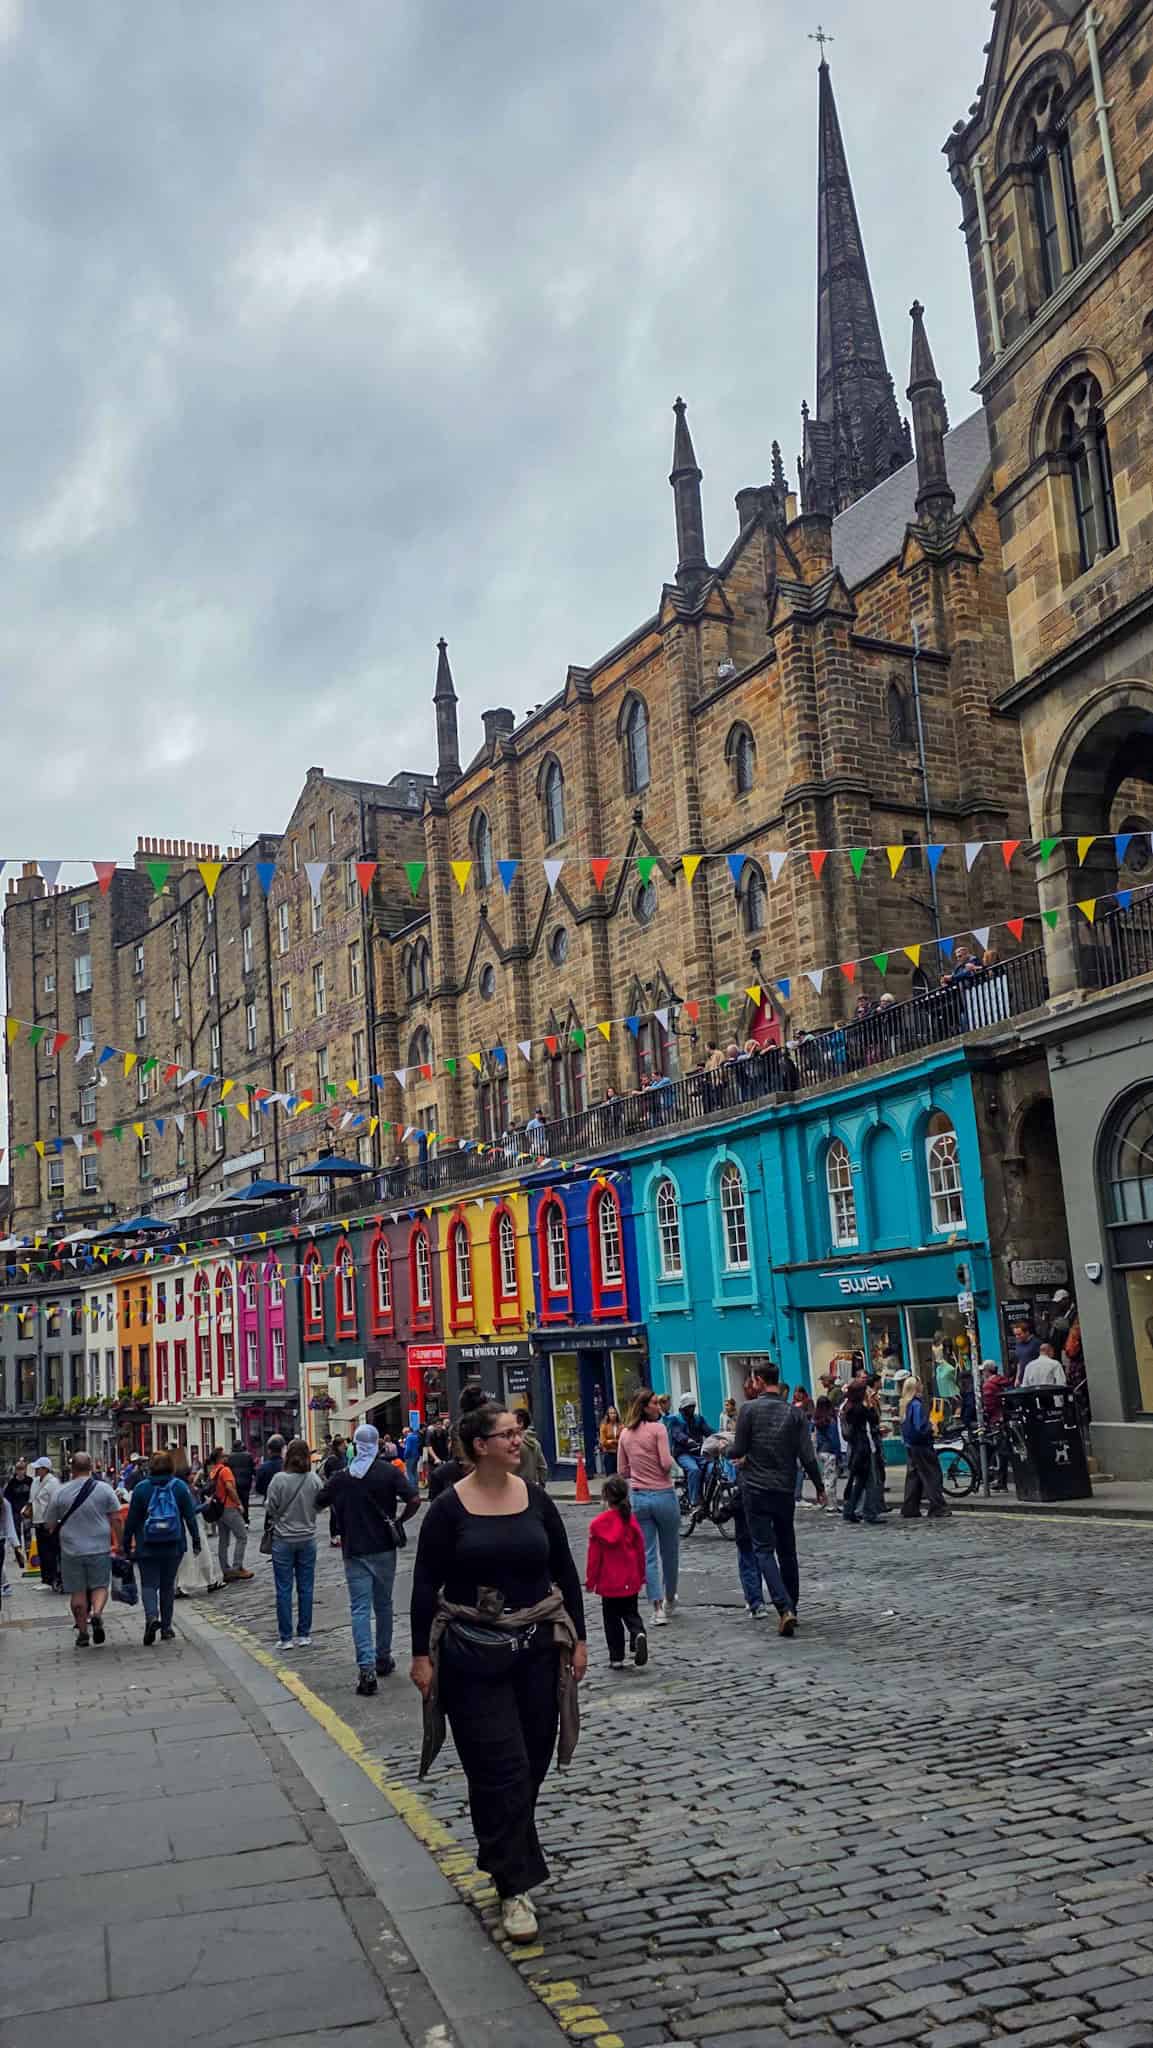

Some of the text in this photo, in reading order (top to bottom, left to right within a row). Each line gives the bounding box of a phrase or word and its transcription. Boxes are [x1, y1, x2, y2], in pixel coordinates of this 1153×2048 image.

[838, 1274, 892, 1294] SWISH
[461, 1345, 518, 1357] THE WHISKY SHOP
